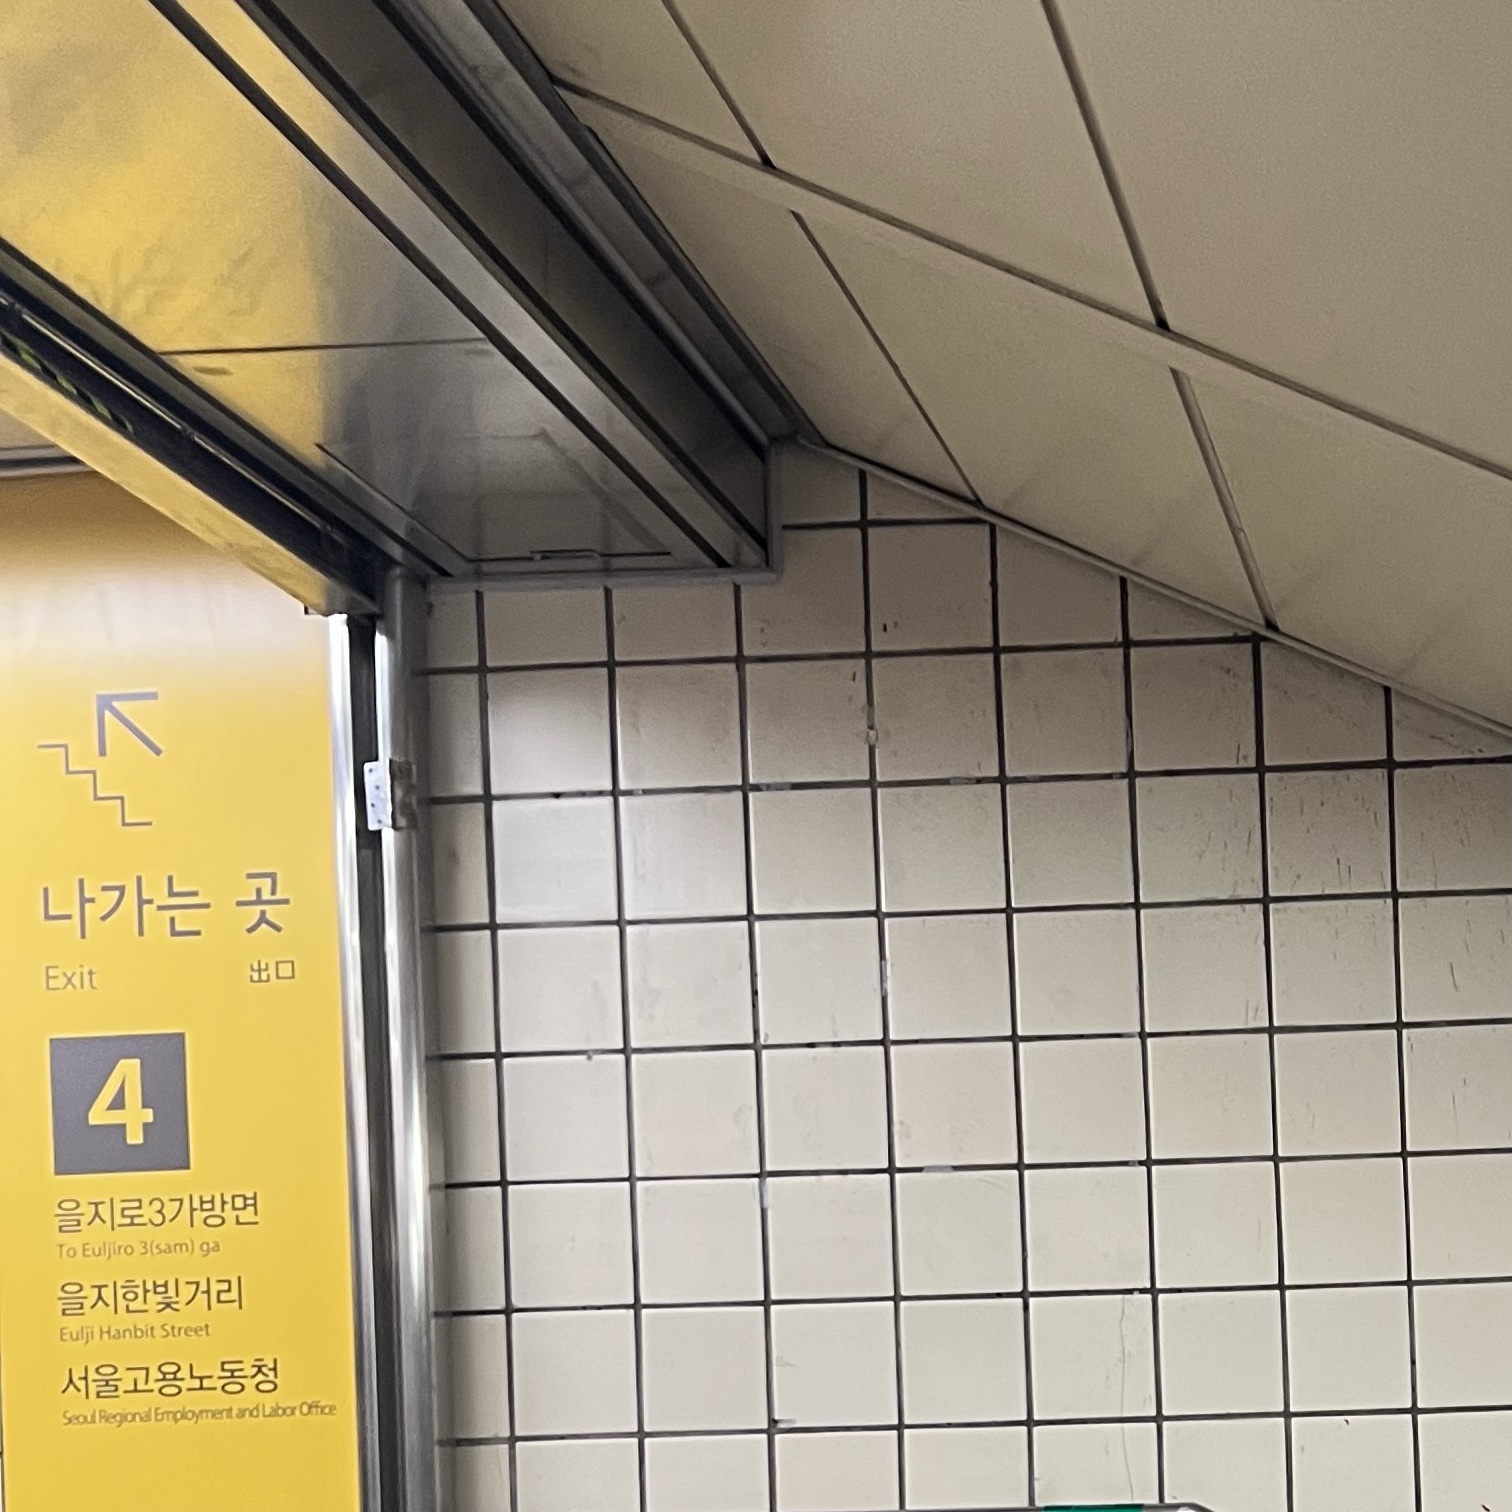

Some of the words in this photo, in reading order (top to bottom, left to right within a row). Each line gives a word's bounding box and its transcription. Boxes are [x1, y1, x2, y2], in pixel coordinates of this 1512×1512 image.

[42, 874, 211, 940] 나가는
[235, 871, 291, 935] 곳
[44, 964, 98, 991] Exit
[249, 959, 296, 984] 出口
[87, 1057, 154, 1146] 4
[54, 1190, 260, 1234] 을지로3가방면
[57, 1243, 78, 1260] To
[82, 1240, 135, 1262] Euljiro
[139, 1238, 195, 1257] 3(sam)
[199, 1240, 221, 1259] ga
[57, 1275, 244, 1317] 을지한빛거리
[59, 1325, 95, 1346] Eulji
[99, 1323, 156, 1341] Hanbit
[160, 1322, 211, 1339] Street
[61, 1356, 280, 1400] 서울고용노동청
[62, 1409, 97, 1426] Seoul
[99, 1407, 152, 1428] Regional
[154, 1405, 233, 1425] Employment
[235, 1403, 259, 1418] and
[261, 1402, 297, 1418] Labor
[300, 1400, 338, 1417] Office
